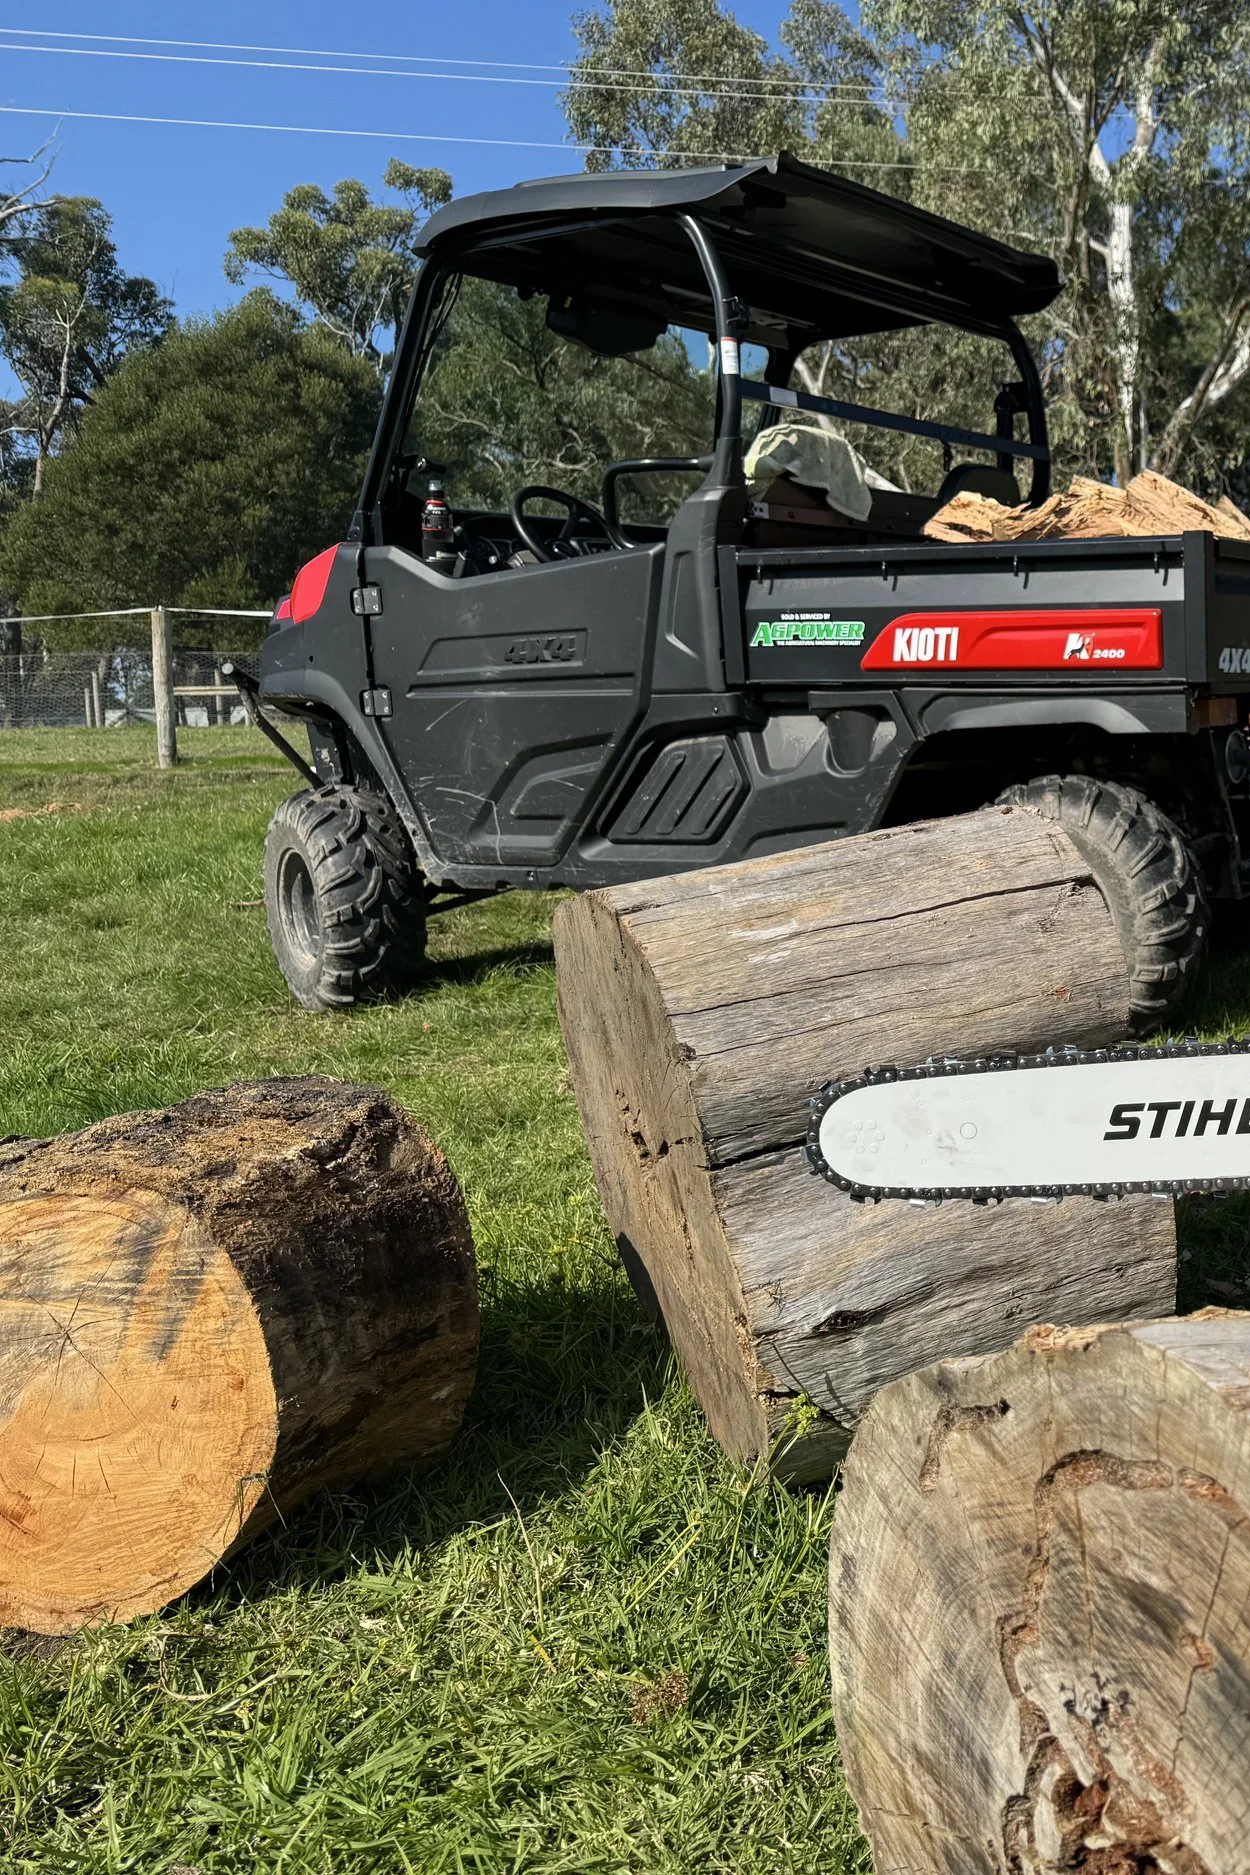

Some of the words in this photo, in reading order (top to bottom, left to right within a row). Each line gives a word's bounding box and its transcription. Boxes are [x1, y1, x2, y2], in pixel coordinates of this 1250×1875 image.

[750, 621, 865, 647] AGPOWER
[893, 626, 959, 662] KIOTI
[504, 635, 577, 664] 4X4
[1092, 649, 1125, 659] 2400
